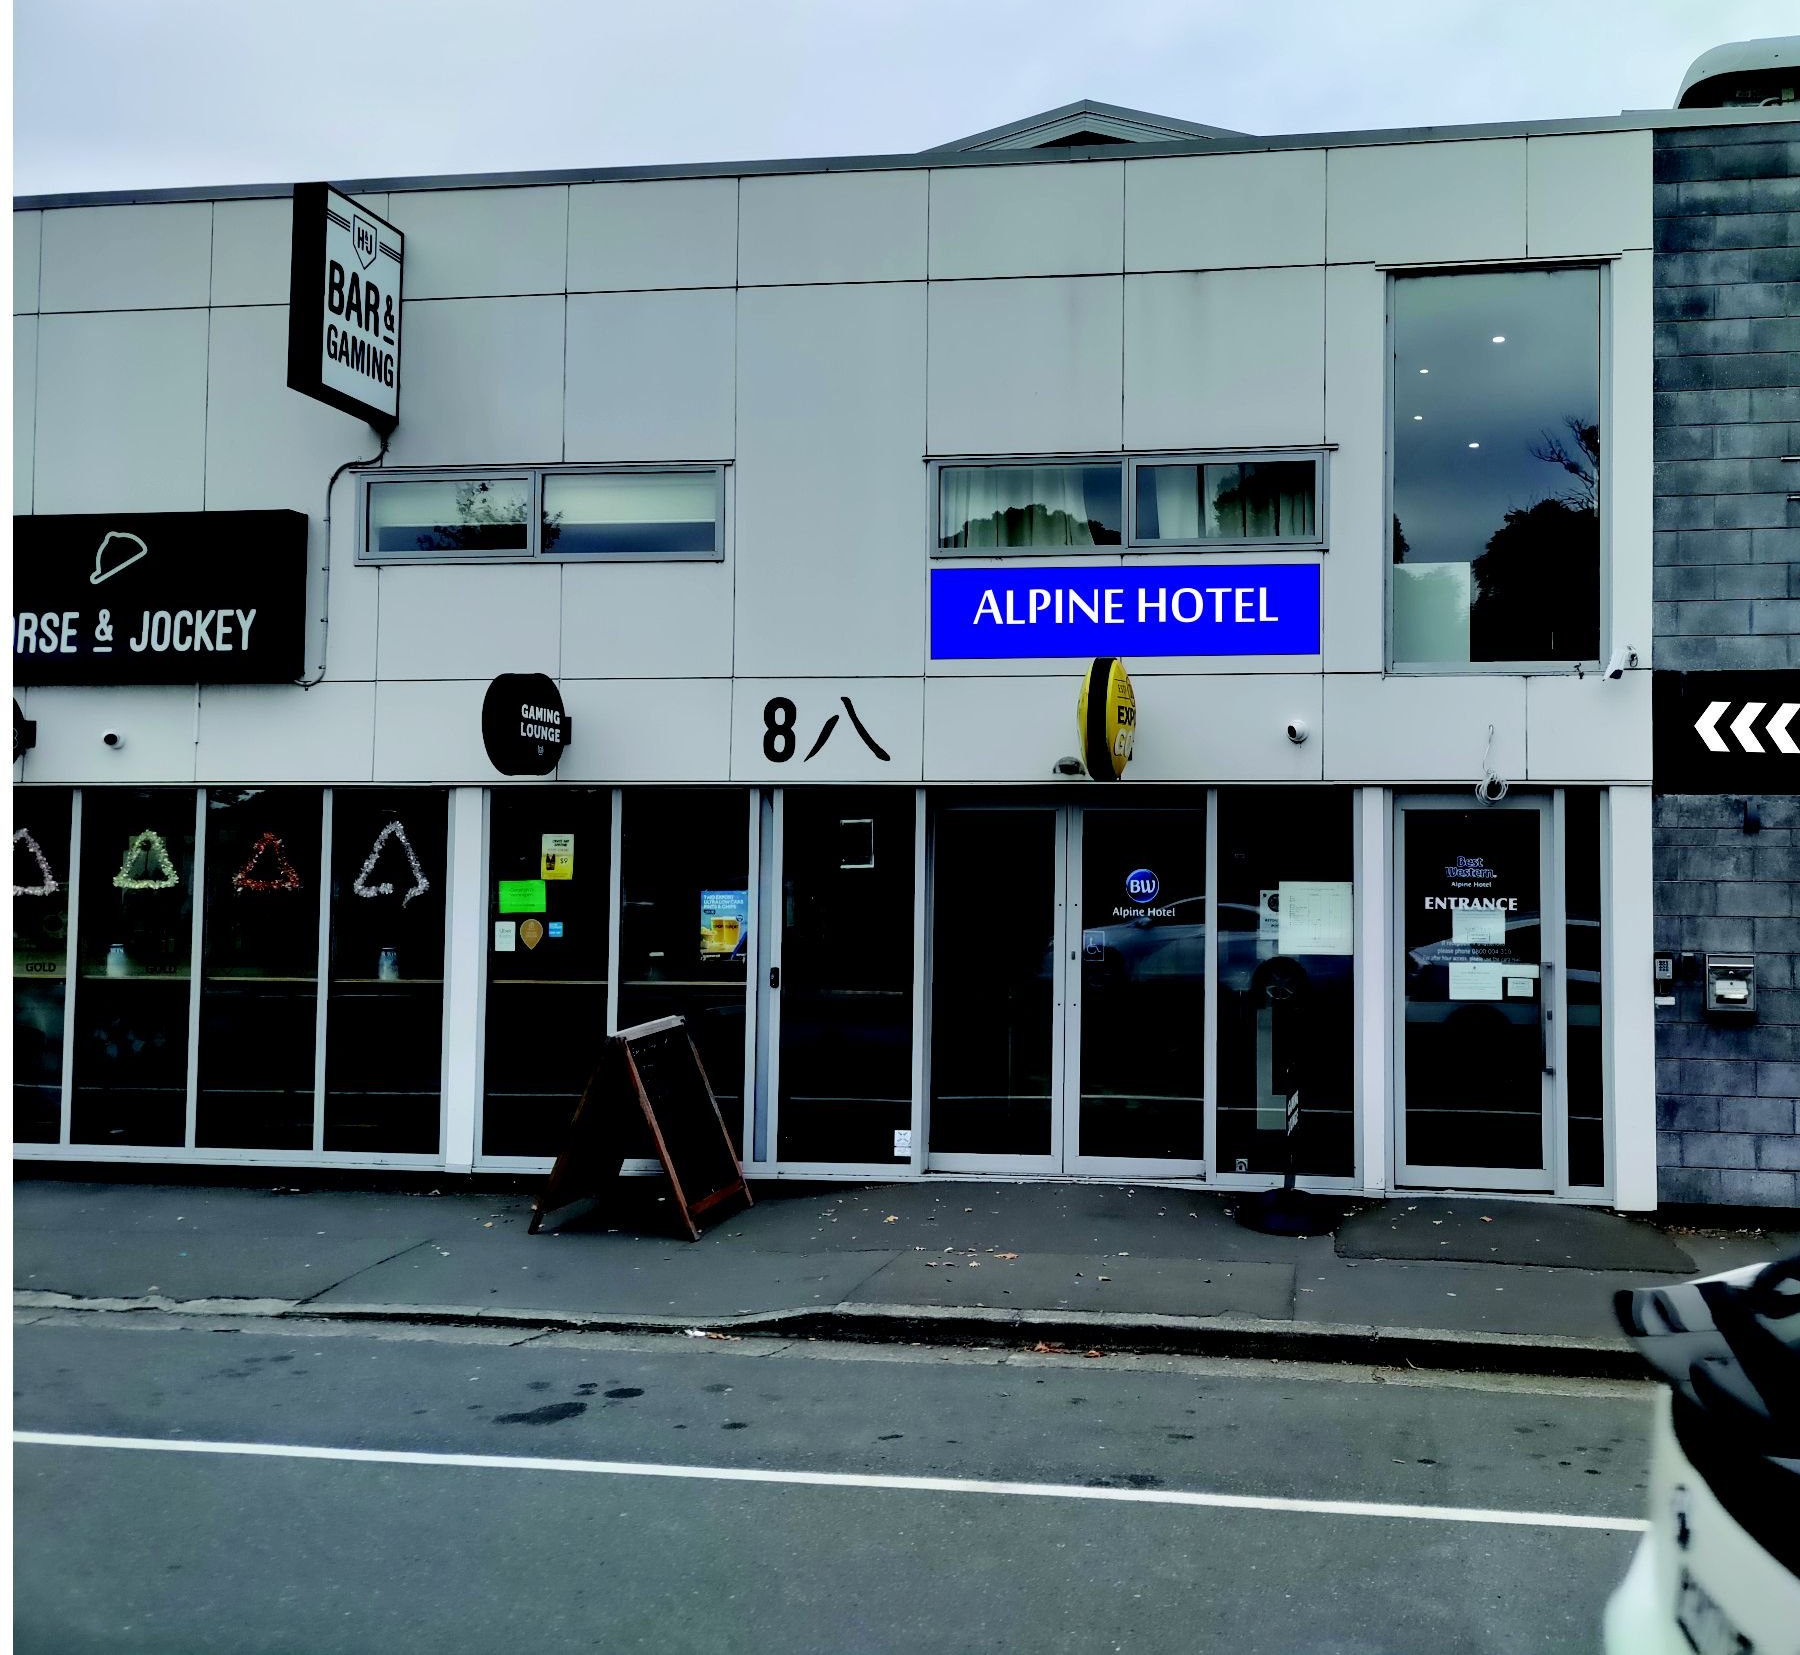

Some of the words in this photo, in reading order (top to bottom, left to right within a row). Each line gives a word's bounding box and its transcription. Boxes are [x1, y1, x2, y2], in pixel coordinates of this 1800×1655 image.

[328, 259, 380, 338] BAR
[383, 294, 395, 346] &
[326, 323, 394, 389] GAMING
[973, 589, 1125, 625] ALPINE
[1137, 587, 1279, 624] HOTEL
[13, 611, 80, 654] RSE
[93, 608, 114, 653] &
[129, 608, 257, 653] JOCKEY
[521, 704, 561, 725] GAMING
[1118, 705, 1137, 726] EXP
[521, 722, 561, 743] LOUNGE
[1457, 856, 1484, 868] Best
[1130, 879, 1156, 894] BW
[1451, 881, 1472, 889] Alpine
[1113, 907, 1145, 919] Alpine
[1148, 908, 1176, 917] Hotel
[1425, 896, 1518, 911] ENTRANCE
[25, 962, 57, 973] GOLD
